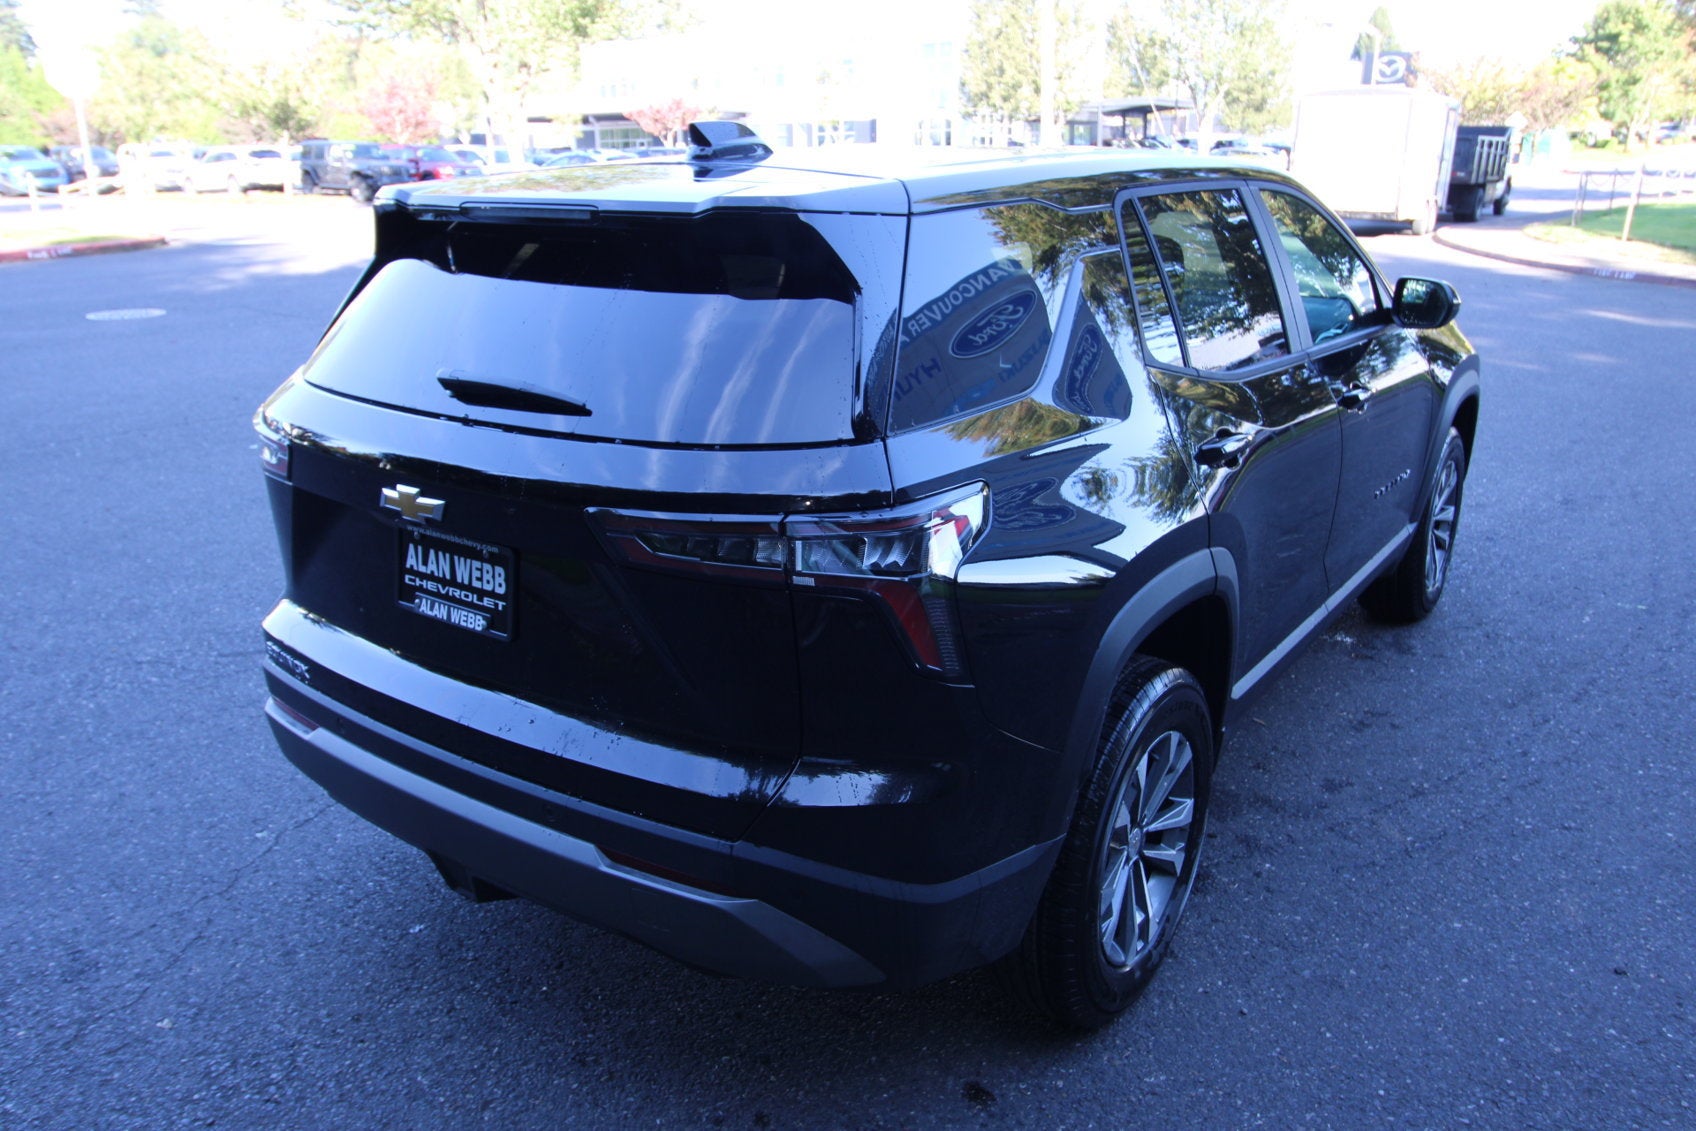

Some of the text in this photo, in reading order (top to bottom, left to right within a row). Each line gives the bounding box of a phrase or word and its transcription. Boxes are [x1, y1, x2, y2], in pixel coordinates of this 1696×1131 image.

[405, 543, 507, 595] ALAN WEBB
[404, 574, 507, 611] CHEVROLET
[419, 598, 485, 631] ALAN WEBB
